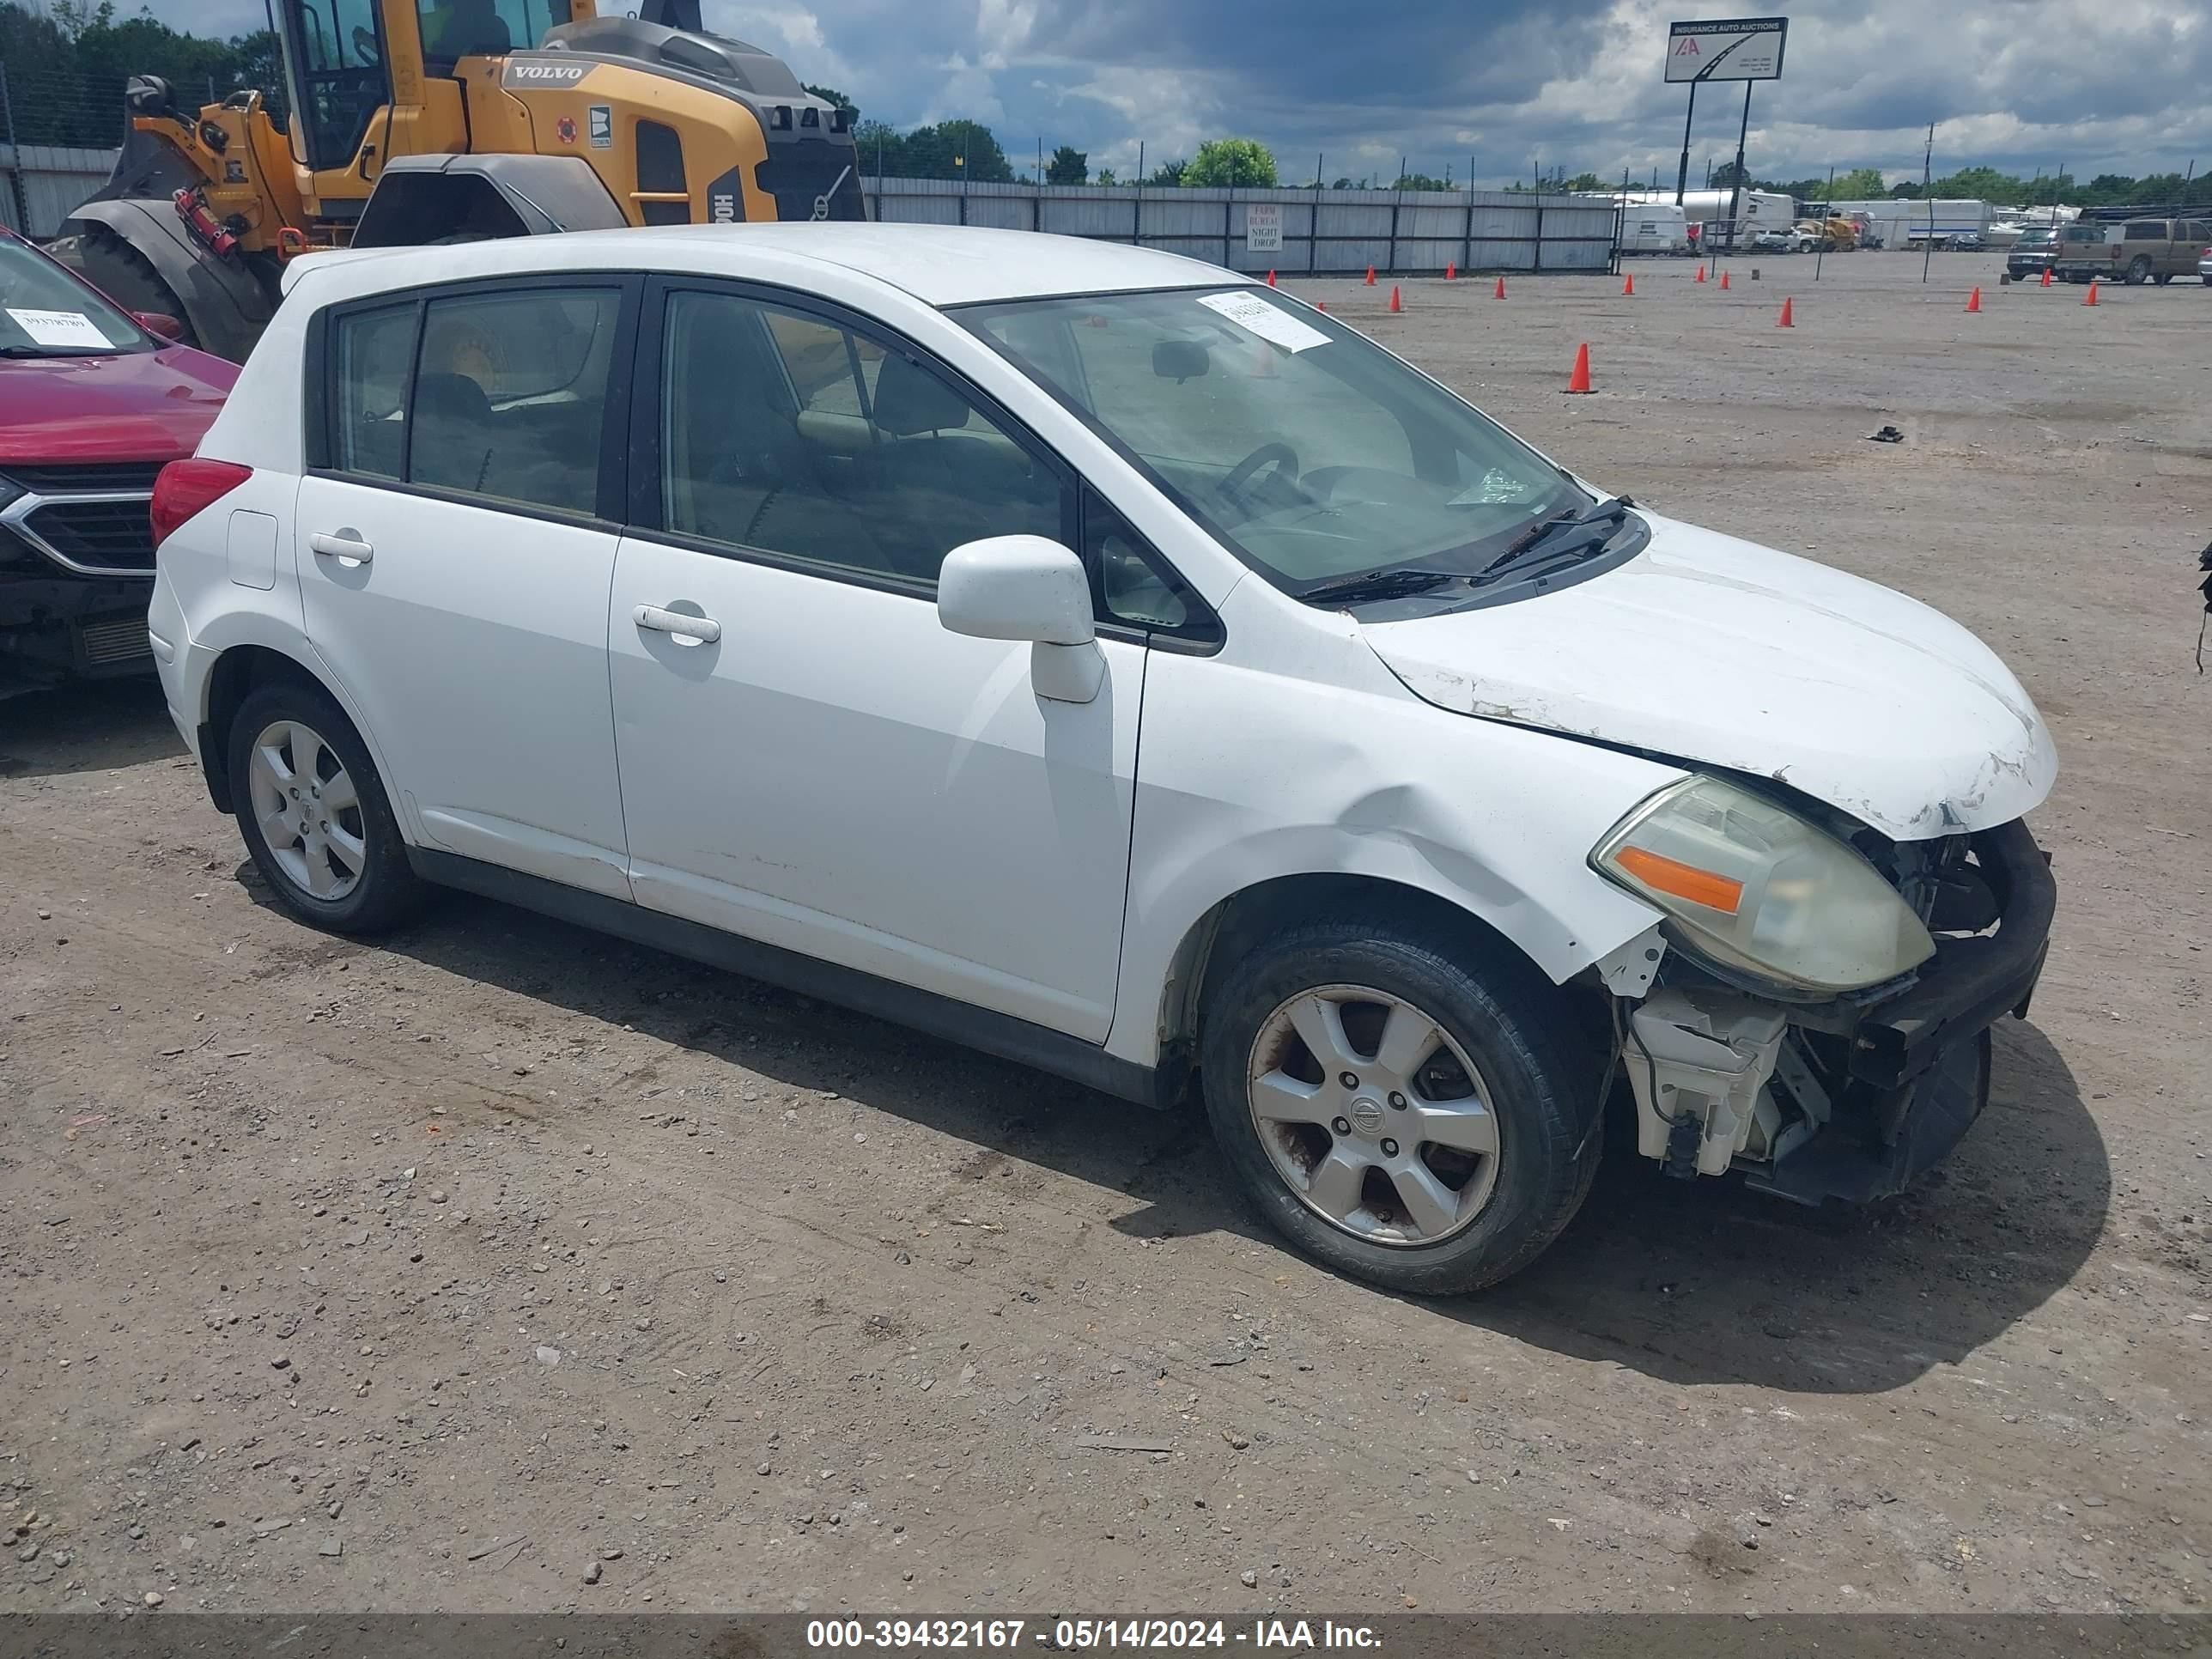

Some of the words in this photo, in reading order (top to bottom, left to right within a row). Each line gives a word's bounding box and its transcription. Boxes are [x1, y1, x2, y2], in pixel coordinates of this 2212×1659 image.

[1674, 25, 1717, 33] INSURANCE
[1741, 22, 1780, 31] AUCTIONS
[514, 66, 582, 80] VOLVO
[1252, 228, 1278, 237] NIGHT
[1254, 239, 1277, 248] DROP
